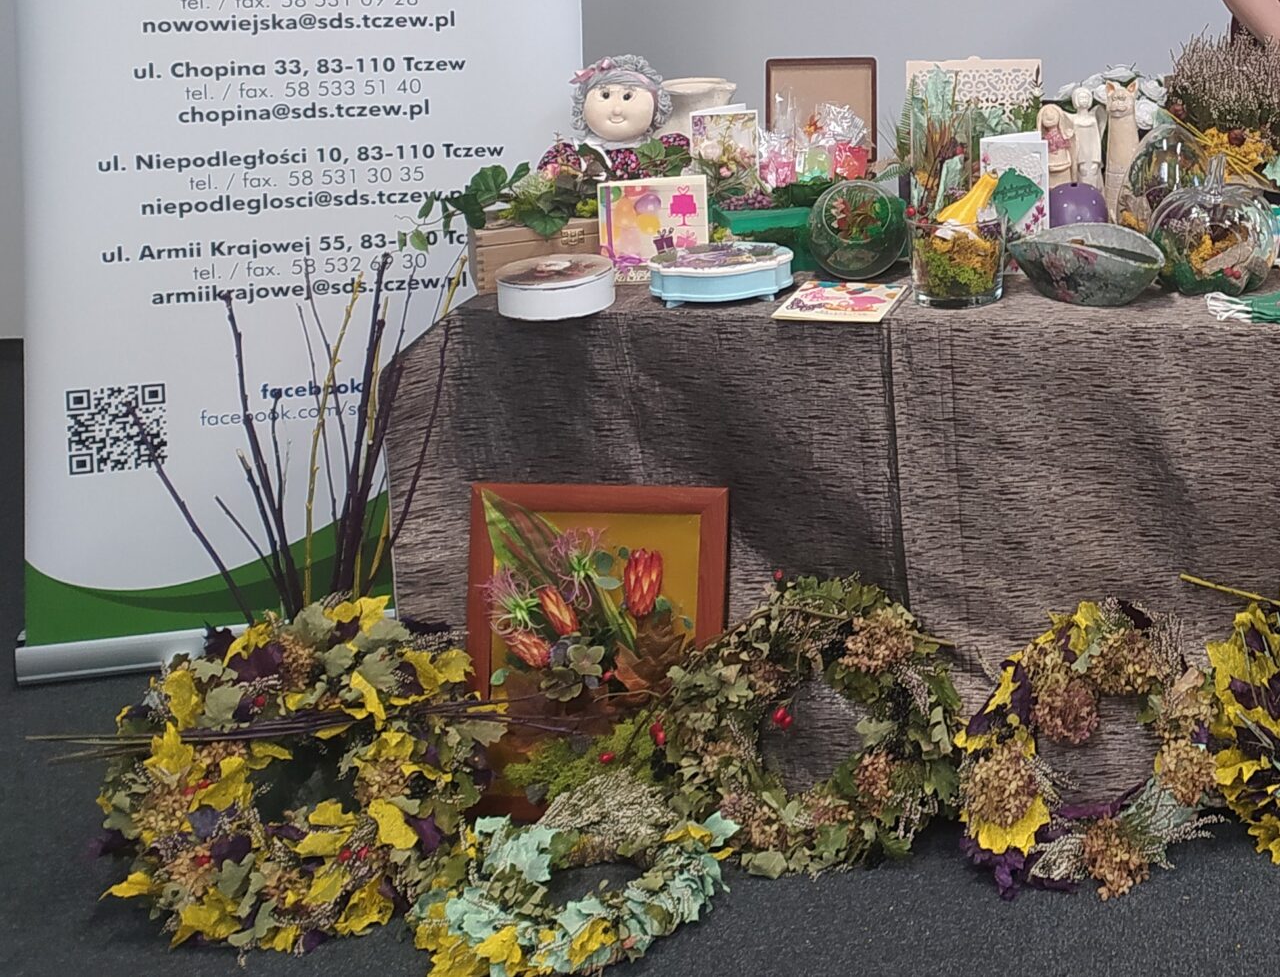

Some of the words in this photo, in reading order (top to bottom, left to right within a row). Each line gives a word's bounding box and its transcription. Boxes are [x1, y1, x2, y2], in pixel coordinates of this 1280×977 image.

[142, 11, 456, 35] nowowiejska@sds.tczew.pl
[134, 62, 162, 80] ul.
[171, 61, 266, 81] Chopina
[274, 59, 308, 77] 33,
[316, 58, 396, 74] 83-110
[403, 57, 466, 72] Tczew
[184, 84, 214, 100] tel.
[239, 82, 274, 99] fax.
[285, 82, 309, 98] 58
[317, 80, 356, 97] 533
[364, 80, 386, 96] 51
[397, 78, 421, 95] 40
[178, 99, 430, 126] chopina@sds.tczew.pl
[98, 156, 126, 173] ul.
[136, 148, 308, 172] Niepodległości
[316, 147, 349, 165] 10,
[357, 144, 435, 161] 83-110
[442, 143, 504, 159] Tczew
[189, 175, 218, 190] tel.
[242, 171, 277, 188] fax.
[289, 170, 313, 187] 58
[322, 169, 356, 185] 531
[367, 167, 392, 184] 30
[400, 166, 424, 183] 35
[141, 186, 470, 217] niepodleglosci@sds.tczew.p
[102, 247, 130, 264] ul.
[139, 242, 201, 261] Armii
[210, 237, 311, 259] Krajowej
[319, 236, 353, 254] 55,
[360, 232, 438, 249] 83-10
[193, 265, 222, 281] tel.
[246, 260, 281, 278] fax.
[291, 258, 316, 275] 58
[324, 257, 361, 274] 532
[402, 253, 427, 270] 30
[152, 273, 467, 305] armiikrajowej@sds.czew.pl
